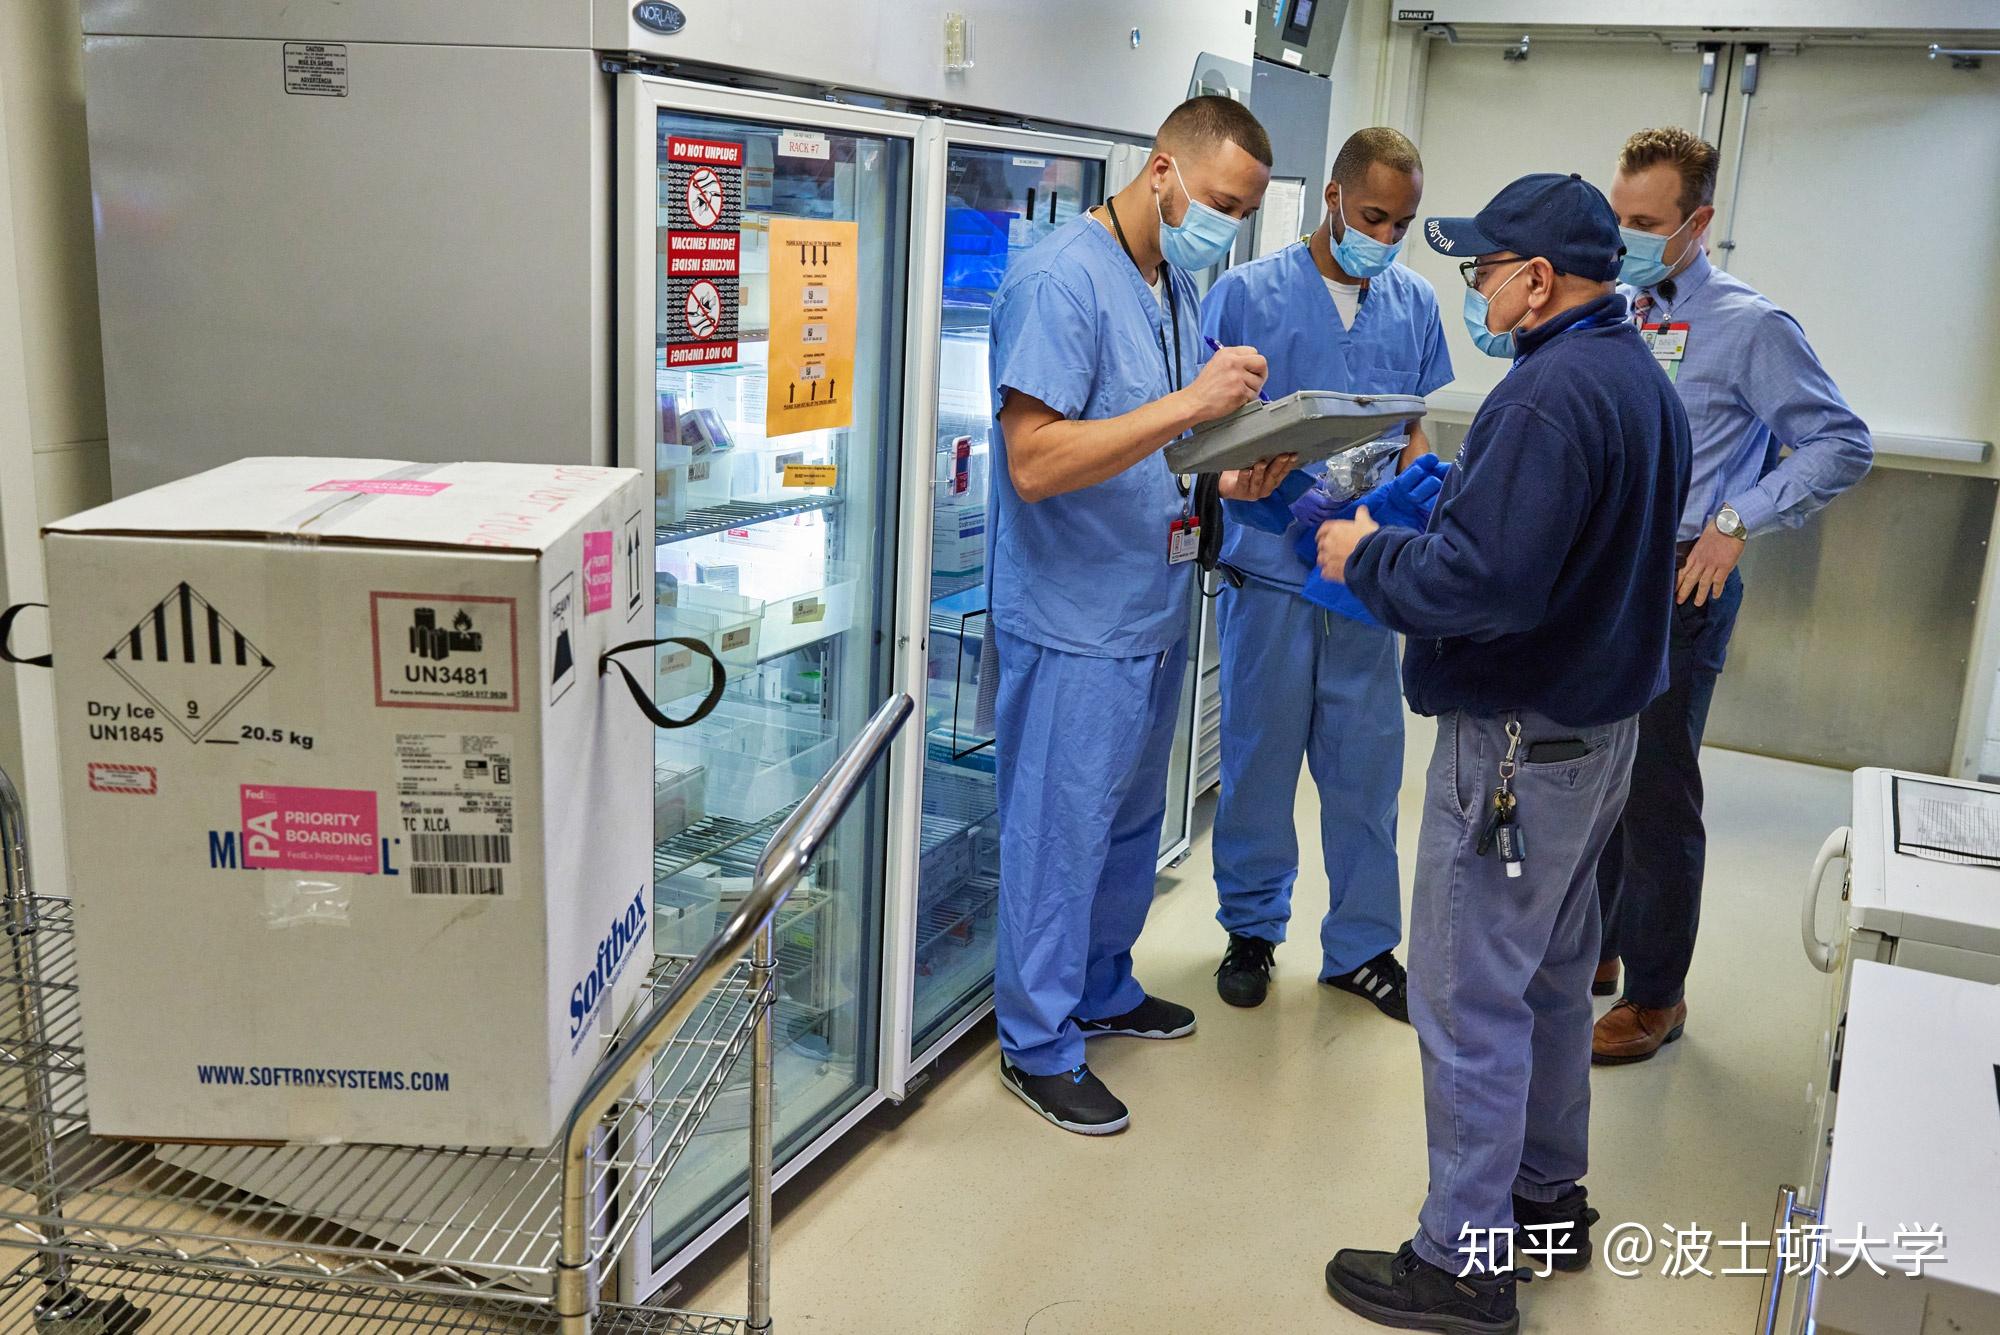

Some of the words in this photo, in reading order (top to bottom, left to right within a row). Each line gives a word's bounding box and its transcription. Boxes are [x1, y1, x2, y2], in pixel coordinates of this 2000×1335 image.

[640, 5, 680, 26] NORLAKE
[1400, 11, 1433, 20] STANLEY
[674, 143, 686, 156] DO
[687, 144, 704, 158] NOT
[704, 145, 738, 161] UNPLUG!
[789, 141, 809, 153] RACK
[672, 237, 706, 250] VACCINES
[708, 238, 735, 251] INSIDE!
[1428, 220, 1455, 251] BOSTON
[672, 258, 701, 272] INSIDE!
[702, 259, 735, 271] VACCINES
[671, 348, 704, 363] UNPLUG!
[705, 347, 721, 360] NOT
[721, 346, 733, 359] DO
[405, 664, 488, 685] UN3481
[88, 701, 121, 721] Dry
[127, 702, 155, 719] Ice
[187, 700, 199, 717] 9
[90, 724, 164, 743] UN1845
[240, 725, 284, 743] 20.5
[290, 731, 314, 750] kg
[284, 811, 360, 827] PRIORITY
[403, 817, 416, 832] TC
[423, 817, 451, 832] XLCA
[247, 810, 280, 858] PA
[286, 829, 373, 846] BOARDING
[316, 852, 344, 863] Priority
[570, 884, 646, 1040] Softbox
[197, 1065, 450, 1092] WWW.SOFTBOXSYSTEMS.COM
